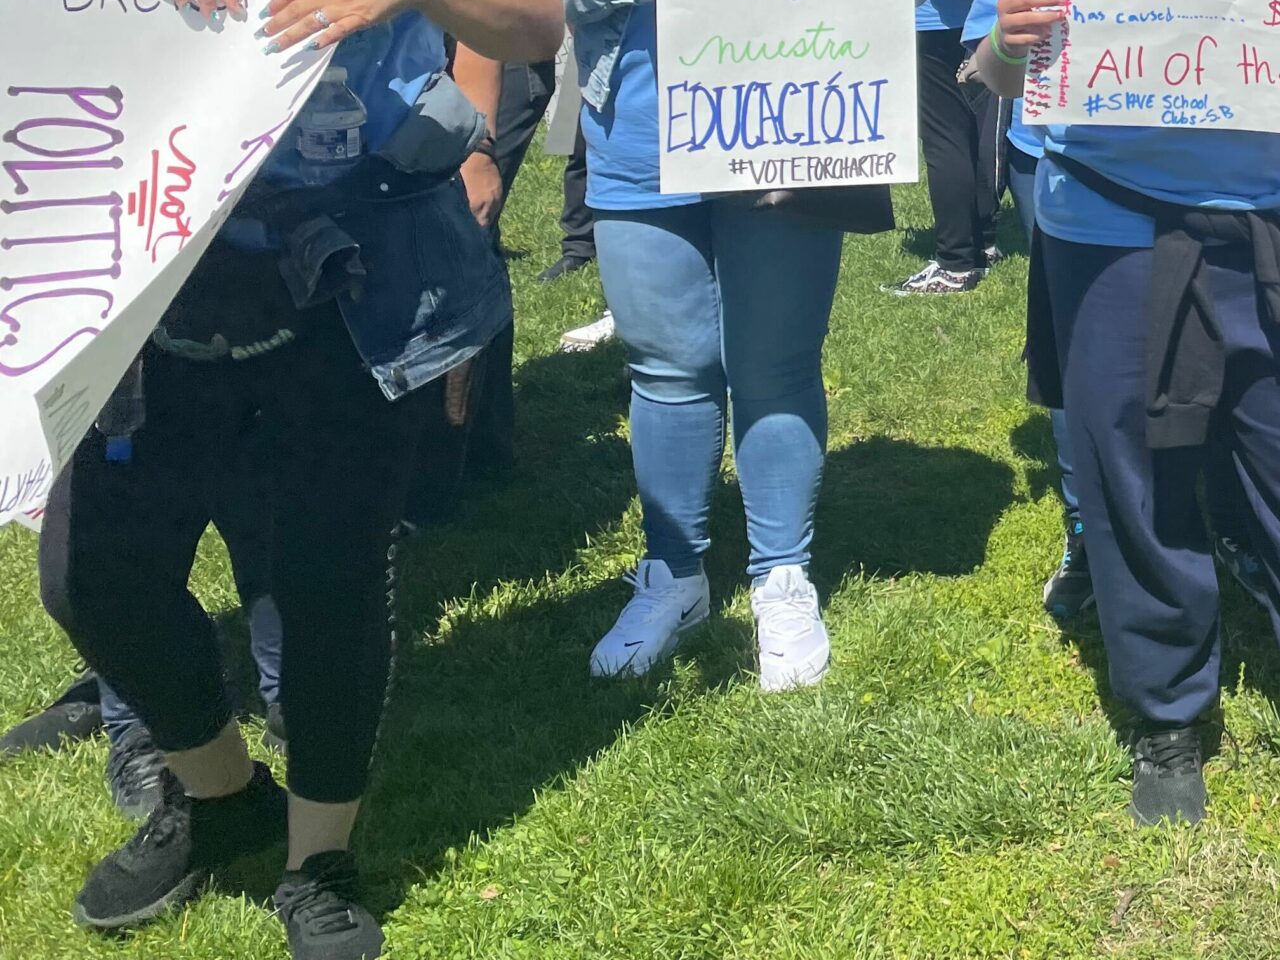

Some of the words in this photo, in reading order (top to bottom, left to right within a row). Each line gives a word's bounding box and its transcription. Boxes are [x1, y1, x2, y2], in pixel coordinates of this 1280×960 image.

[1073, 5, 1106, 24] has
[678, 21, 870, 67] nuestra
[1087, 45, 1144, 89] All
[666, 71, 889, 153] EDUCACIÓN
[0, 84, 125, 377] POLITICS
